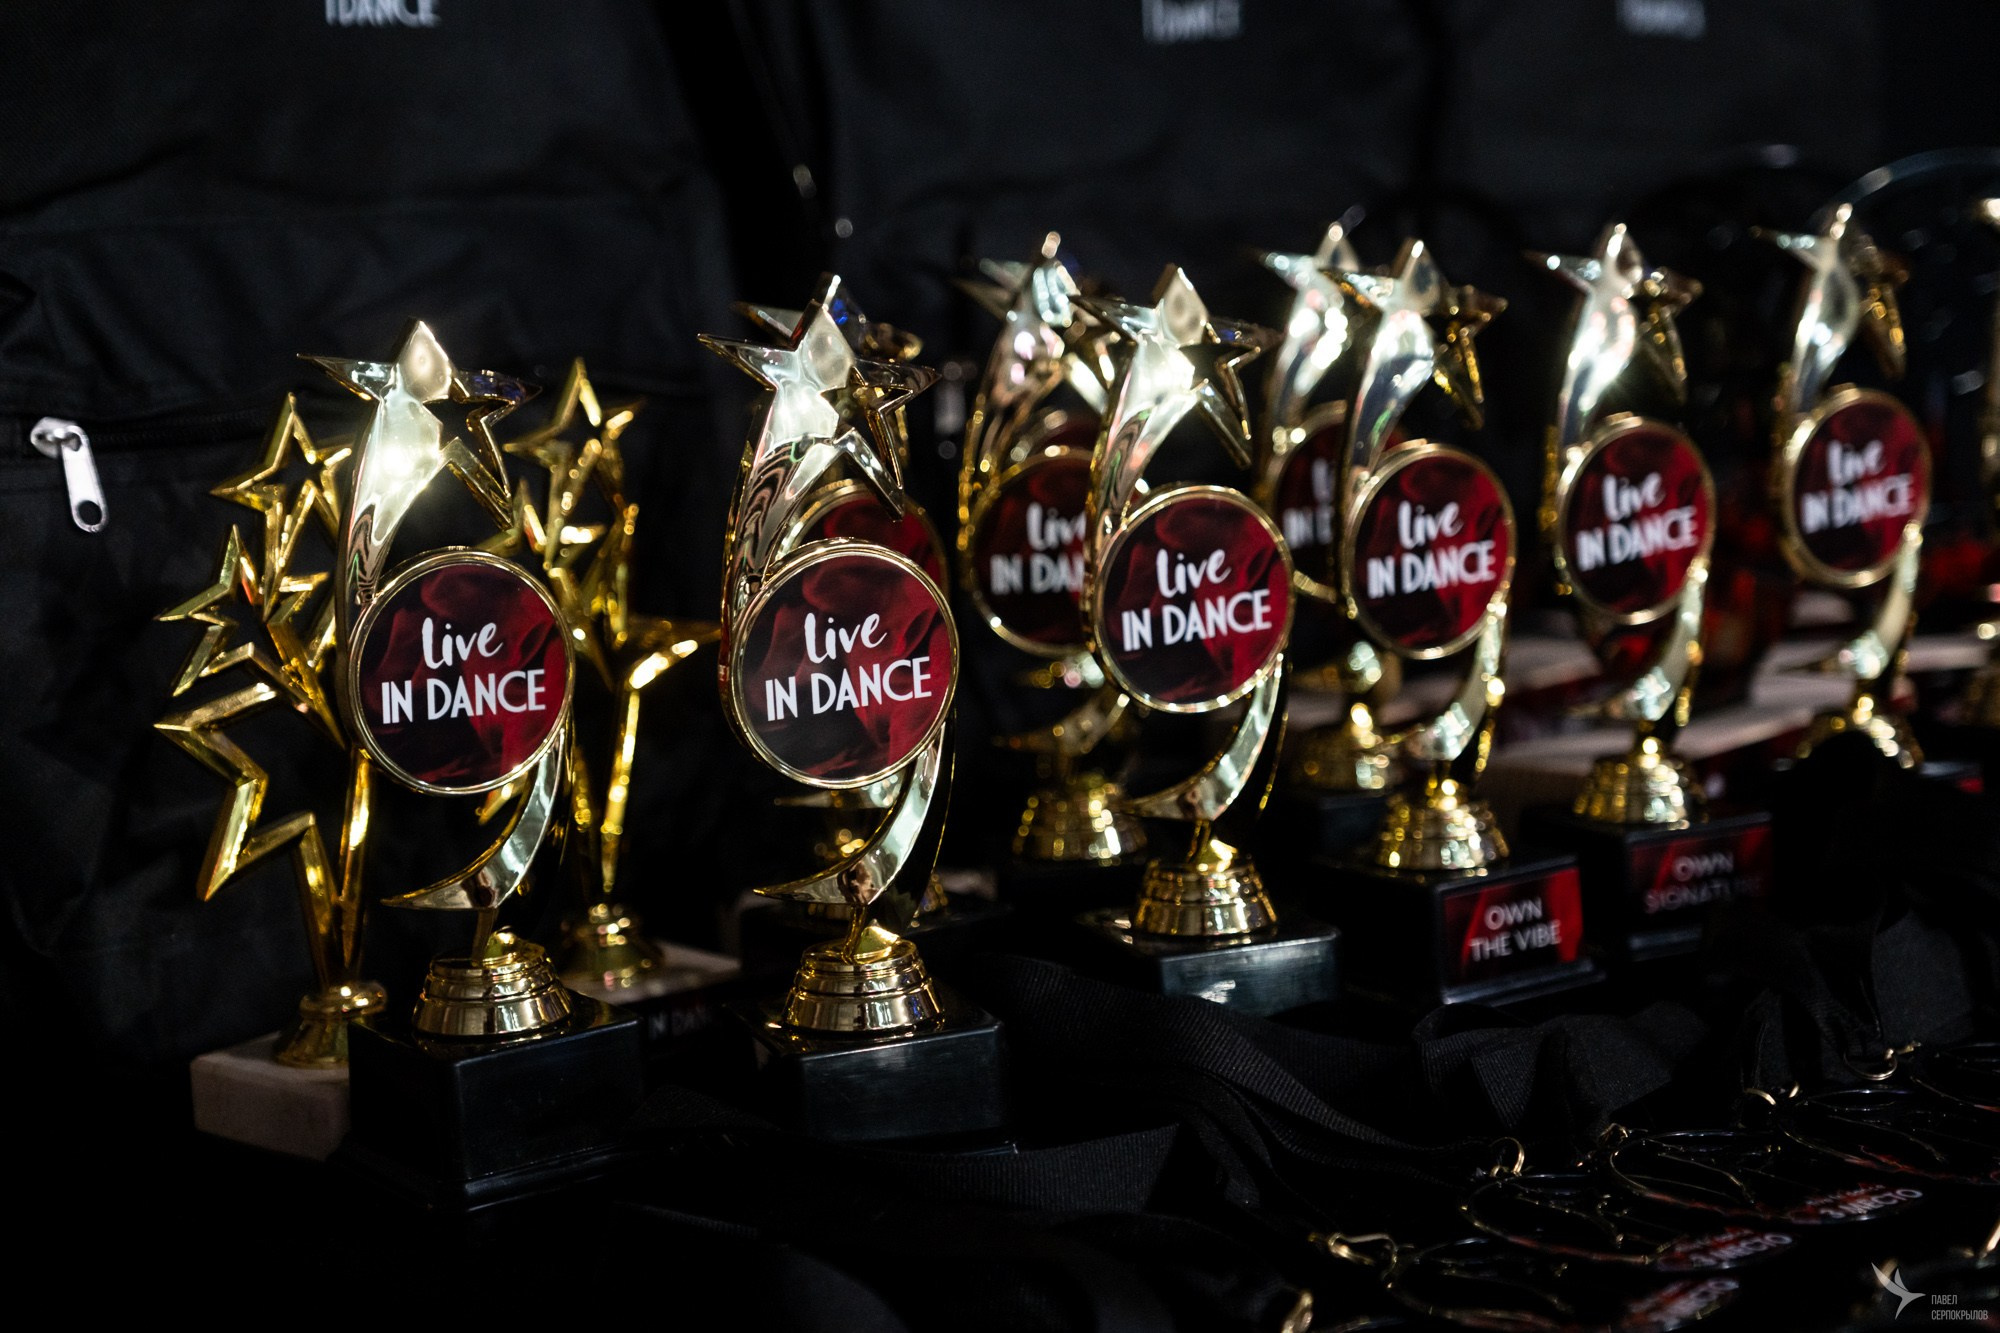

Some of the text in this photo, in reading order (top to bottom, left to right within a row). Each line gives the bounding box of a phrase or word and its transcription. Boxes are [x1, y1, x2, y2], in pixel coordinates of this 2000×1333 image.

[1602, 472, 1666, 523] Live
[1832, 472, 1914, 527] DANCE
[1026, 502, 1087, 551] Liv
[1398, 500, 1463, 549] Live
[1576, 505, 1698, 572] IN DANCE
[991, 553, 1023, 595] IN
[1155, 548, 1232, 599] Live
[1366, 540, 1496, 599] IN DANCE
[420, 616, 503, 670] Live
[802, 611, 888, 665] Live
[1121, 588, 1273, 652] IN DANCE
[380, 668, 547, 725] IN DANCE
[764, 656, 933, 723] IN DANCE
[1673, 853, 1734, 881] OWN
[1468, 919, 1562, 962] THE VIBE
[1484, 898, 1543, 931] OWN
